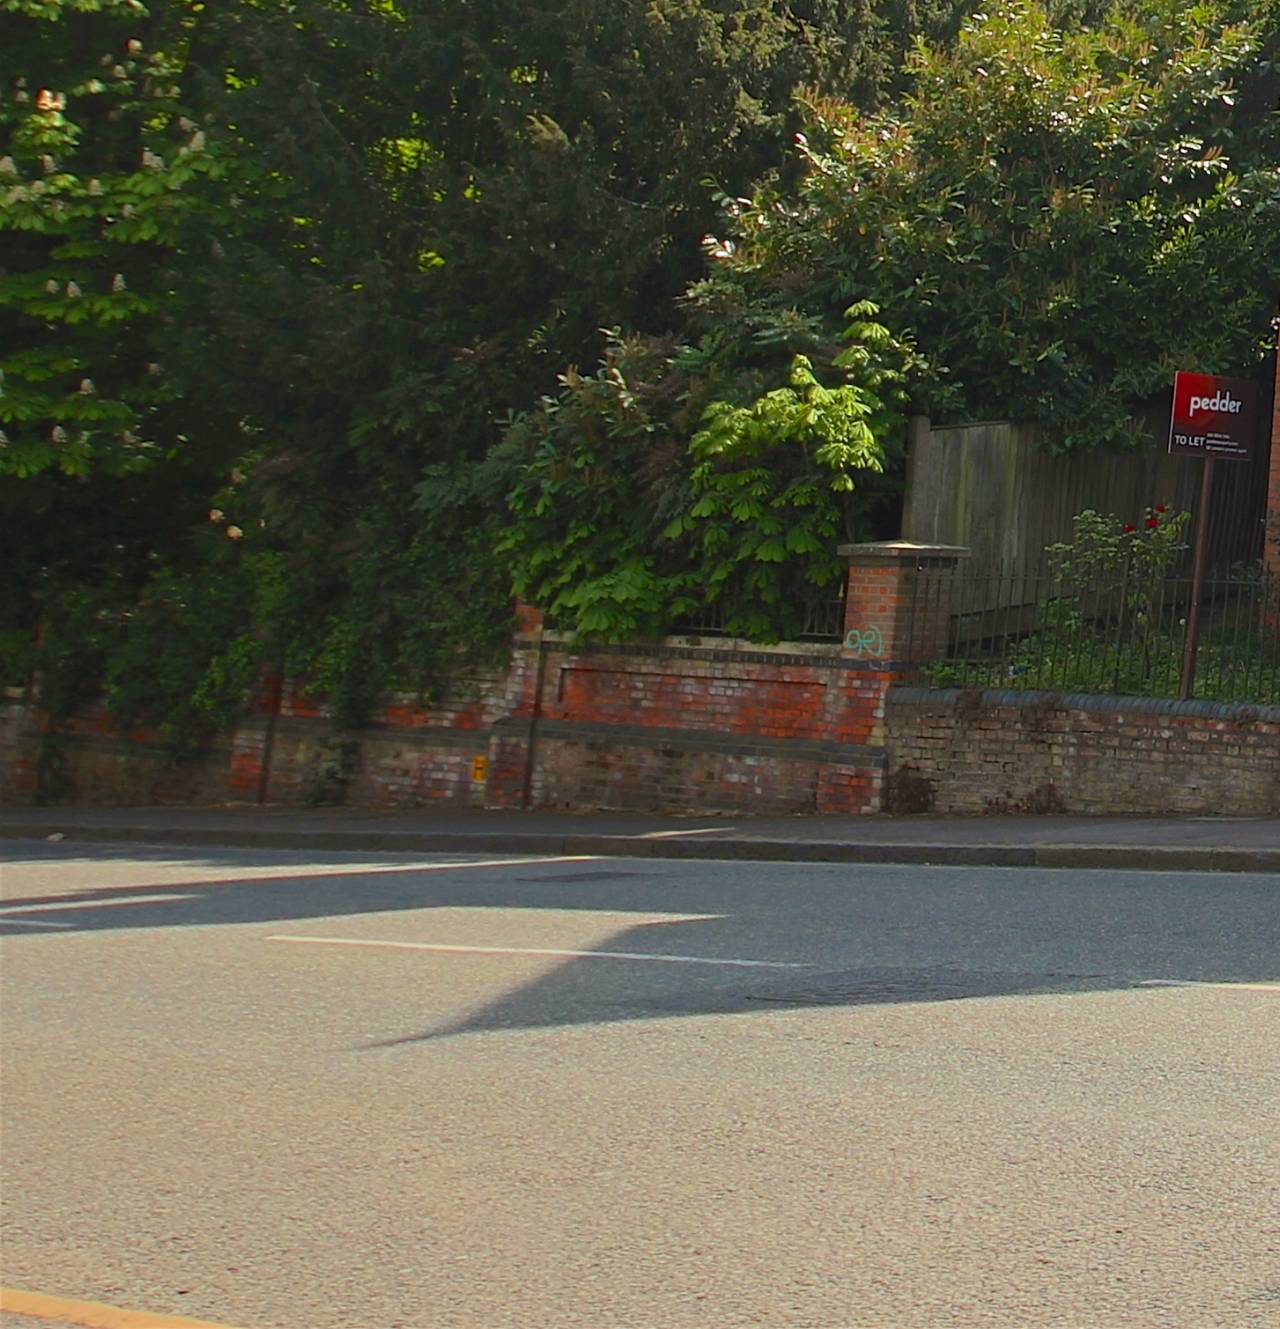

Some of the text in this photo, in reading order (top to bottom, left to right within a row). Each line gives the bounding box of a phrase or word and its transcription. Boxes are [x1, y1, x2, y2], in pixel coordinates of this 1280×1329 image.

[1189, 389, 1242, 418] pedder
[1175, 434, 1187, 446] TO
[1188, 435, 1206, 447] LET
